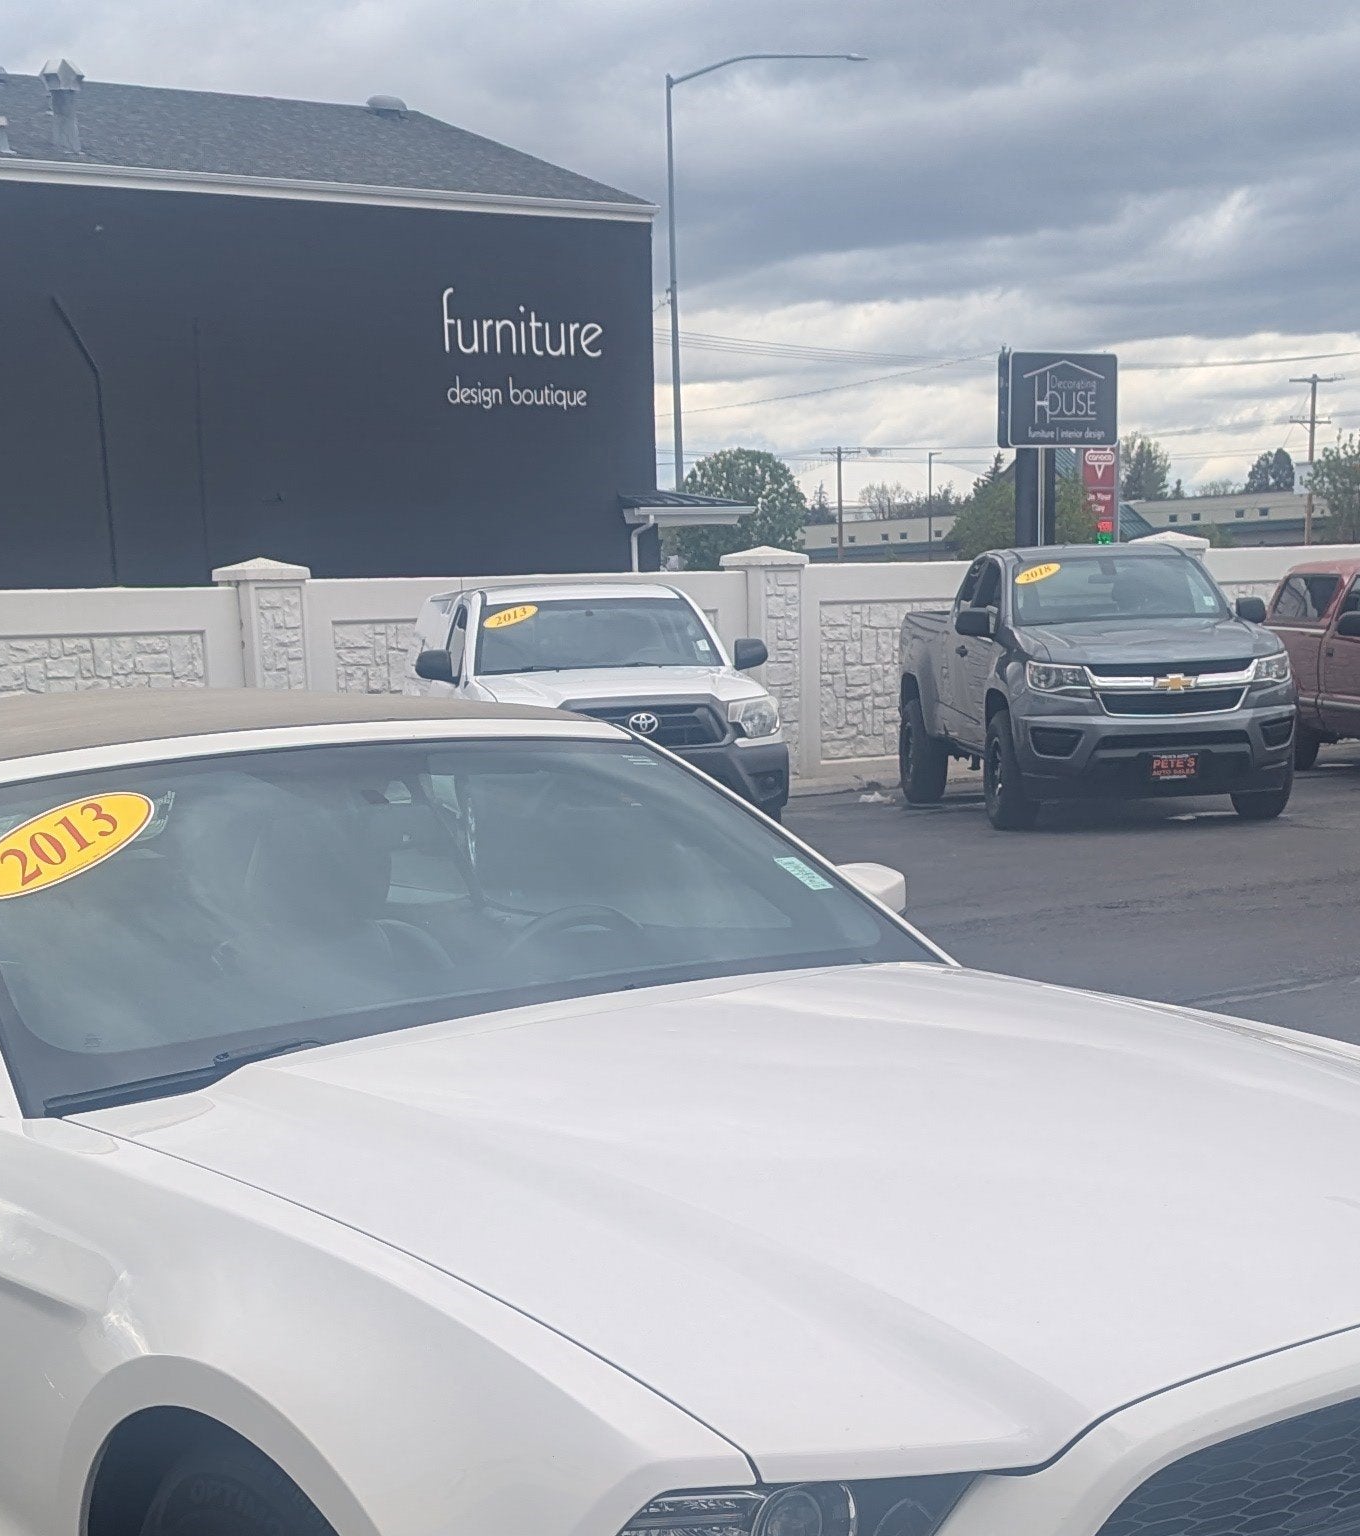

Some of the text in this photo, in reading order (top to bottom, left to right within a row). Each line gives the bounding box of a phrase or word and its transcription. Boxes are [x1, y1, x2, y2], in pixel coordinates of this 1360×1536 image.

[442, 286, 603, 357] furniture
[447, 374, 588, 411] design boutique
[1050, 374, 1097, 391] Decorating
[1084, 426, 1106, 440] design
[495, 607, 528, 626] 2013
[0, 802, 118, 887] 2013
